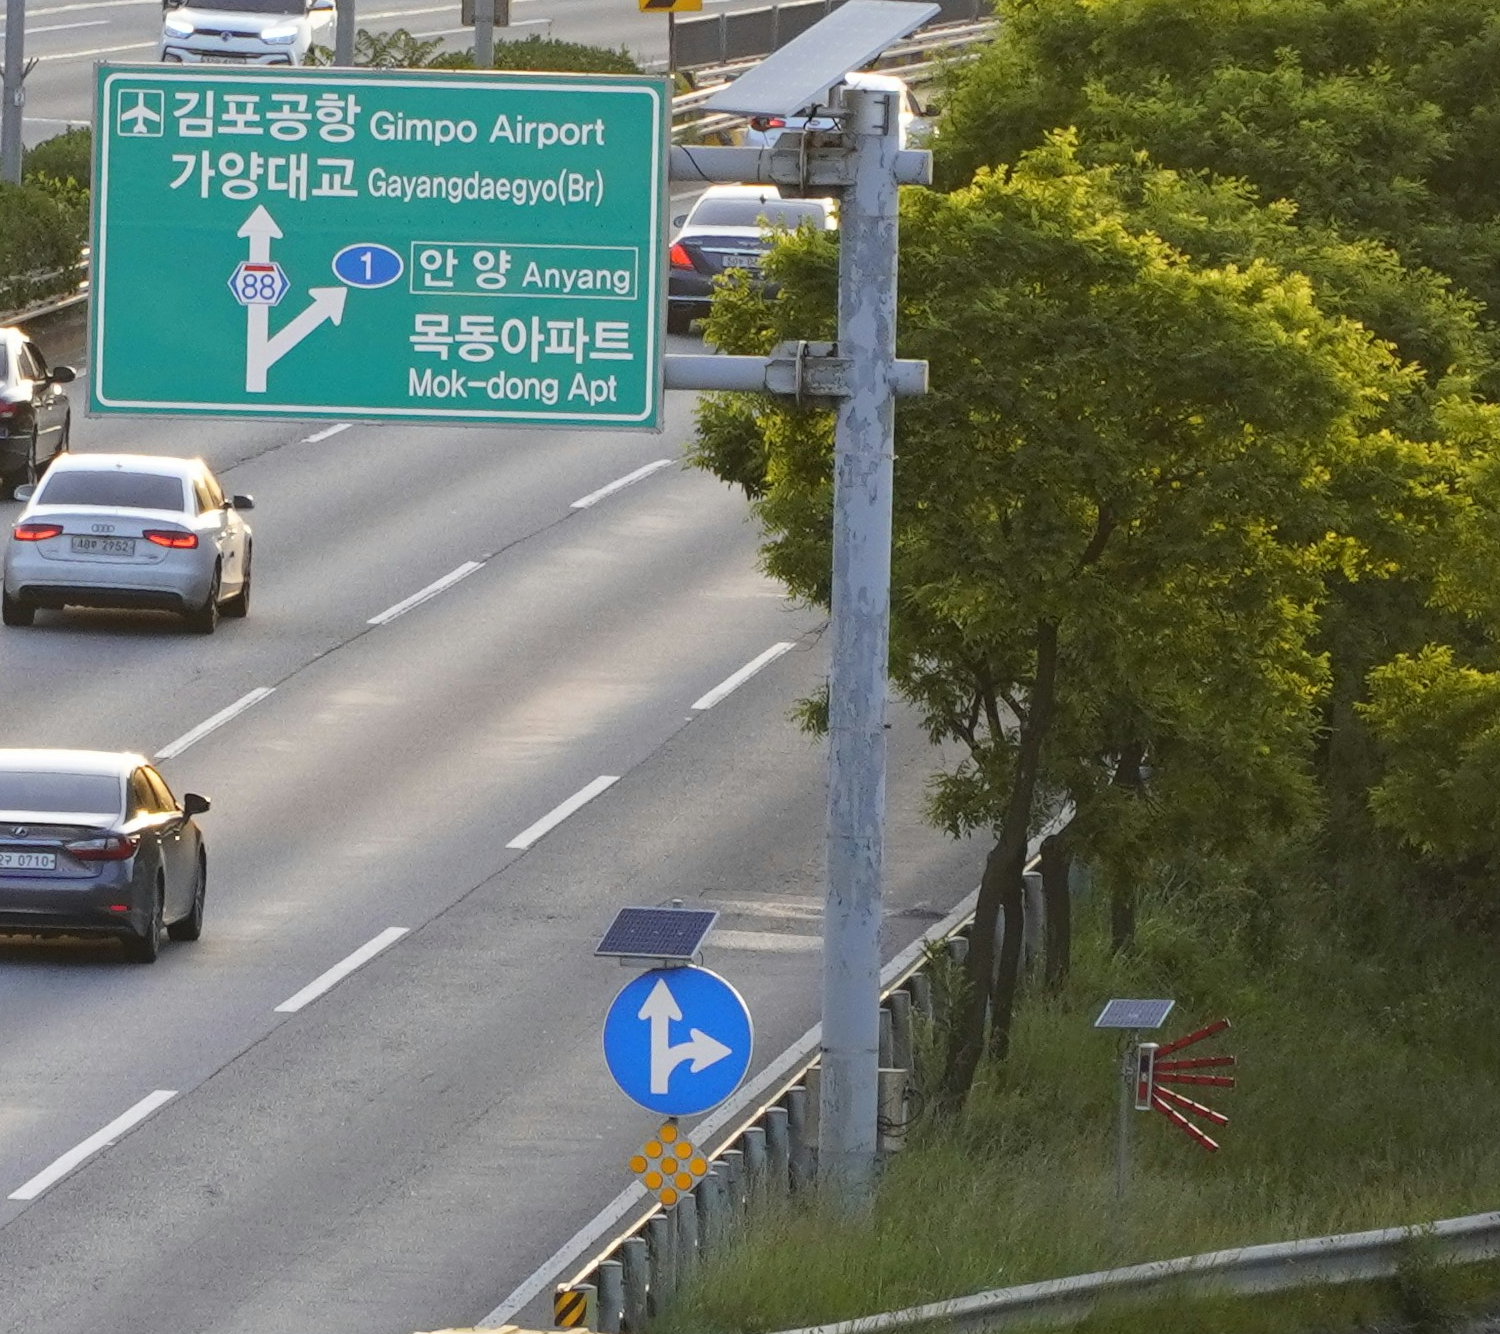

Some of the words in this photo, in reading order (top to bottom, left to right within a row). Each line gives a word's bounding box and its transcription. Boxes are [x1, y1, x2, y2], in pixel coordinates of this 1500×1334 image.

[173, 90, 361, 142] 김포공항
[370, 113, 477, 147] Gimpo
[489, 114, 605, 149] Airport
[170, 151, 358, 201] 가양대교
[367, 167, 604, 207] Gayangdaegyo(Br)
[359, 252, 373, 280] 1
[522, 260, 631, 297] Anyang
[241, 274, 275, 301] 88
[409, 313, 634, 364] 목동아파트
[409, 368, 558, 404] Mok-dong
[566, 373, 618, 407] Apt
[18, 854, 49, 867] 0710
